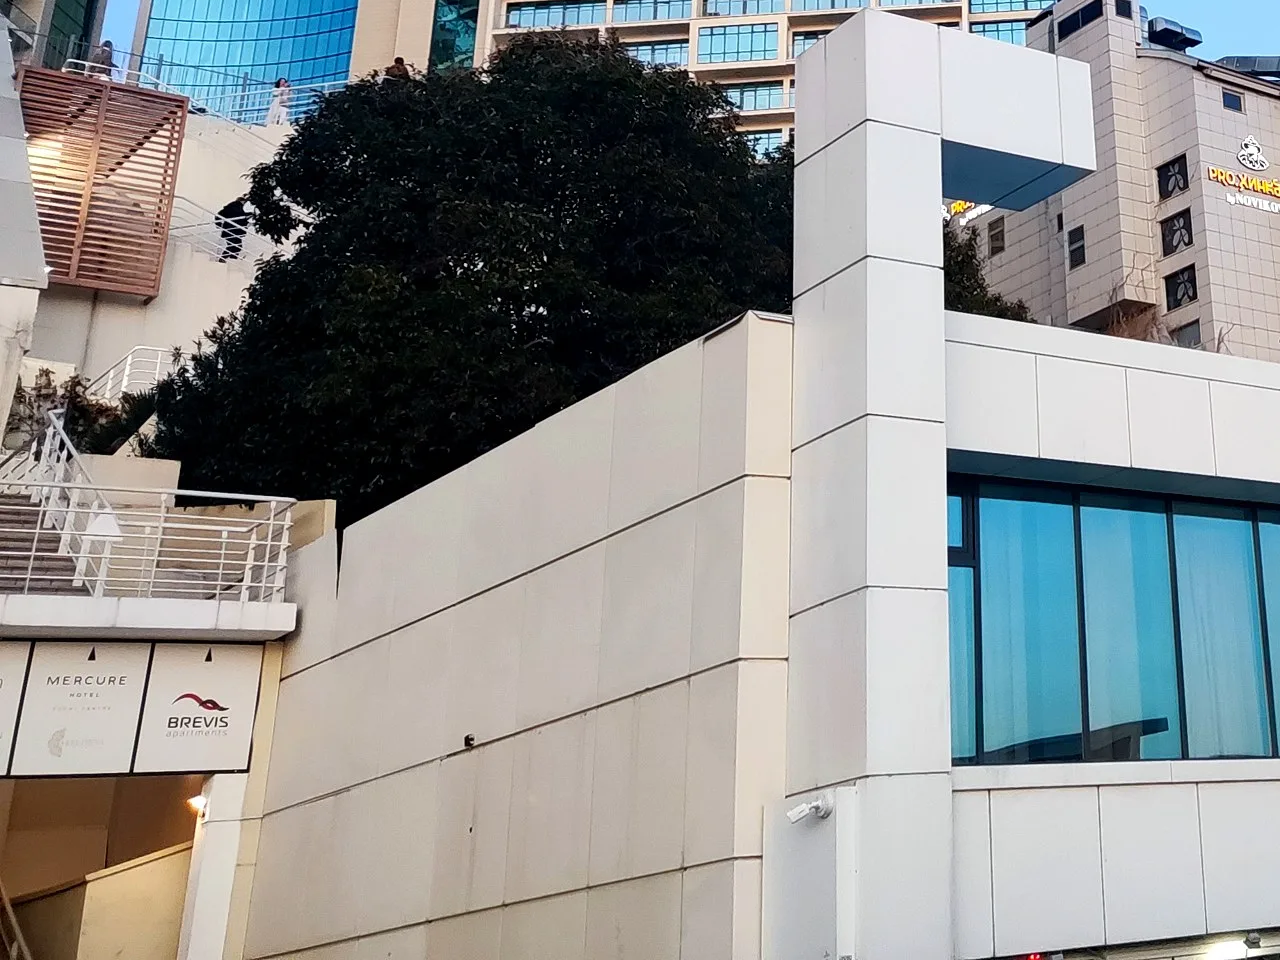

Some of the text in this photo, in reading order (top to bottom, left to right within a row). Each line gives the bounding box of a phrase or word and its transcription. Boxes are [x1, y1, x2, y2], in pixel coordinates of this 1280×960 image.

[46, 676, 128, 686] MERCURE
[167, 716, 229, 729] BREVIS
[165, 729, 229, 738] apartments
